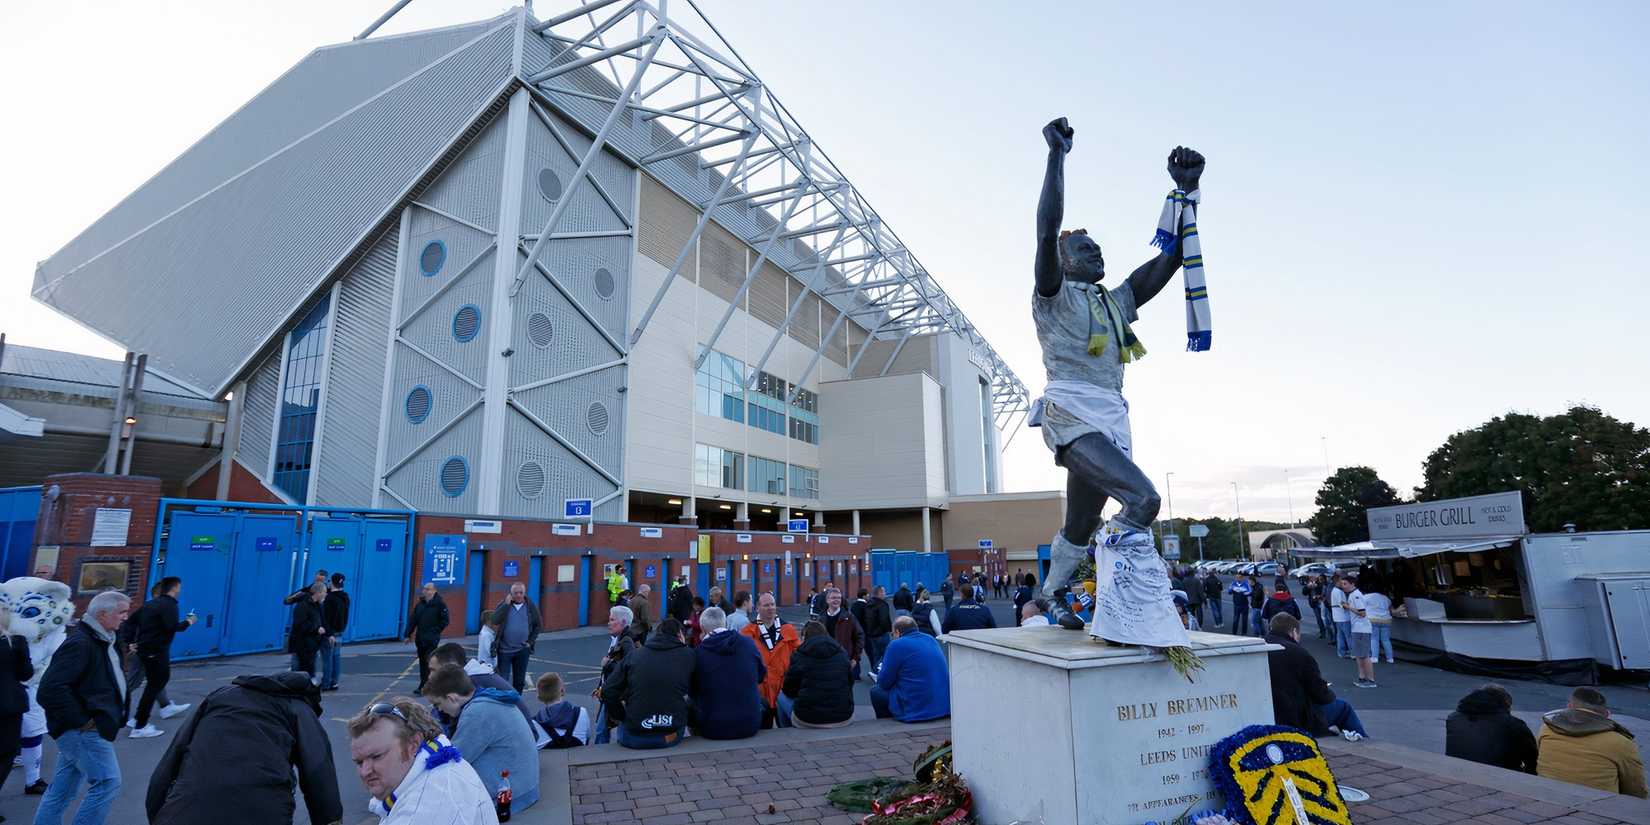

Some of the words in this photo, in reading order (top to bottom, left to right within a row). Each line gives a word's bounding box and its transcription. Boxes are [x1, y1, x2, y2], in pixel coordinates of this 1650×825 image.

[1395, 509, 1438, 529] BURGER
[1440, 506, 1476, 526] GRILL
[1116, 702, 1158, 721] BILLY
[1167, 693, 1239, 716] BREMNER
[1158, 727, 1176, 740] 1942
[1187, 724, 1205, 736] 1997
[1140, 749, 1177, 766] LEEDS
[1182, 743, 1217, 761] UNIT
[1161, 773, 1181, 786] 1959
[1142, 793, 1201, 810] APPEARANCES
